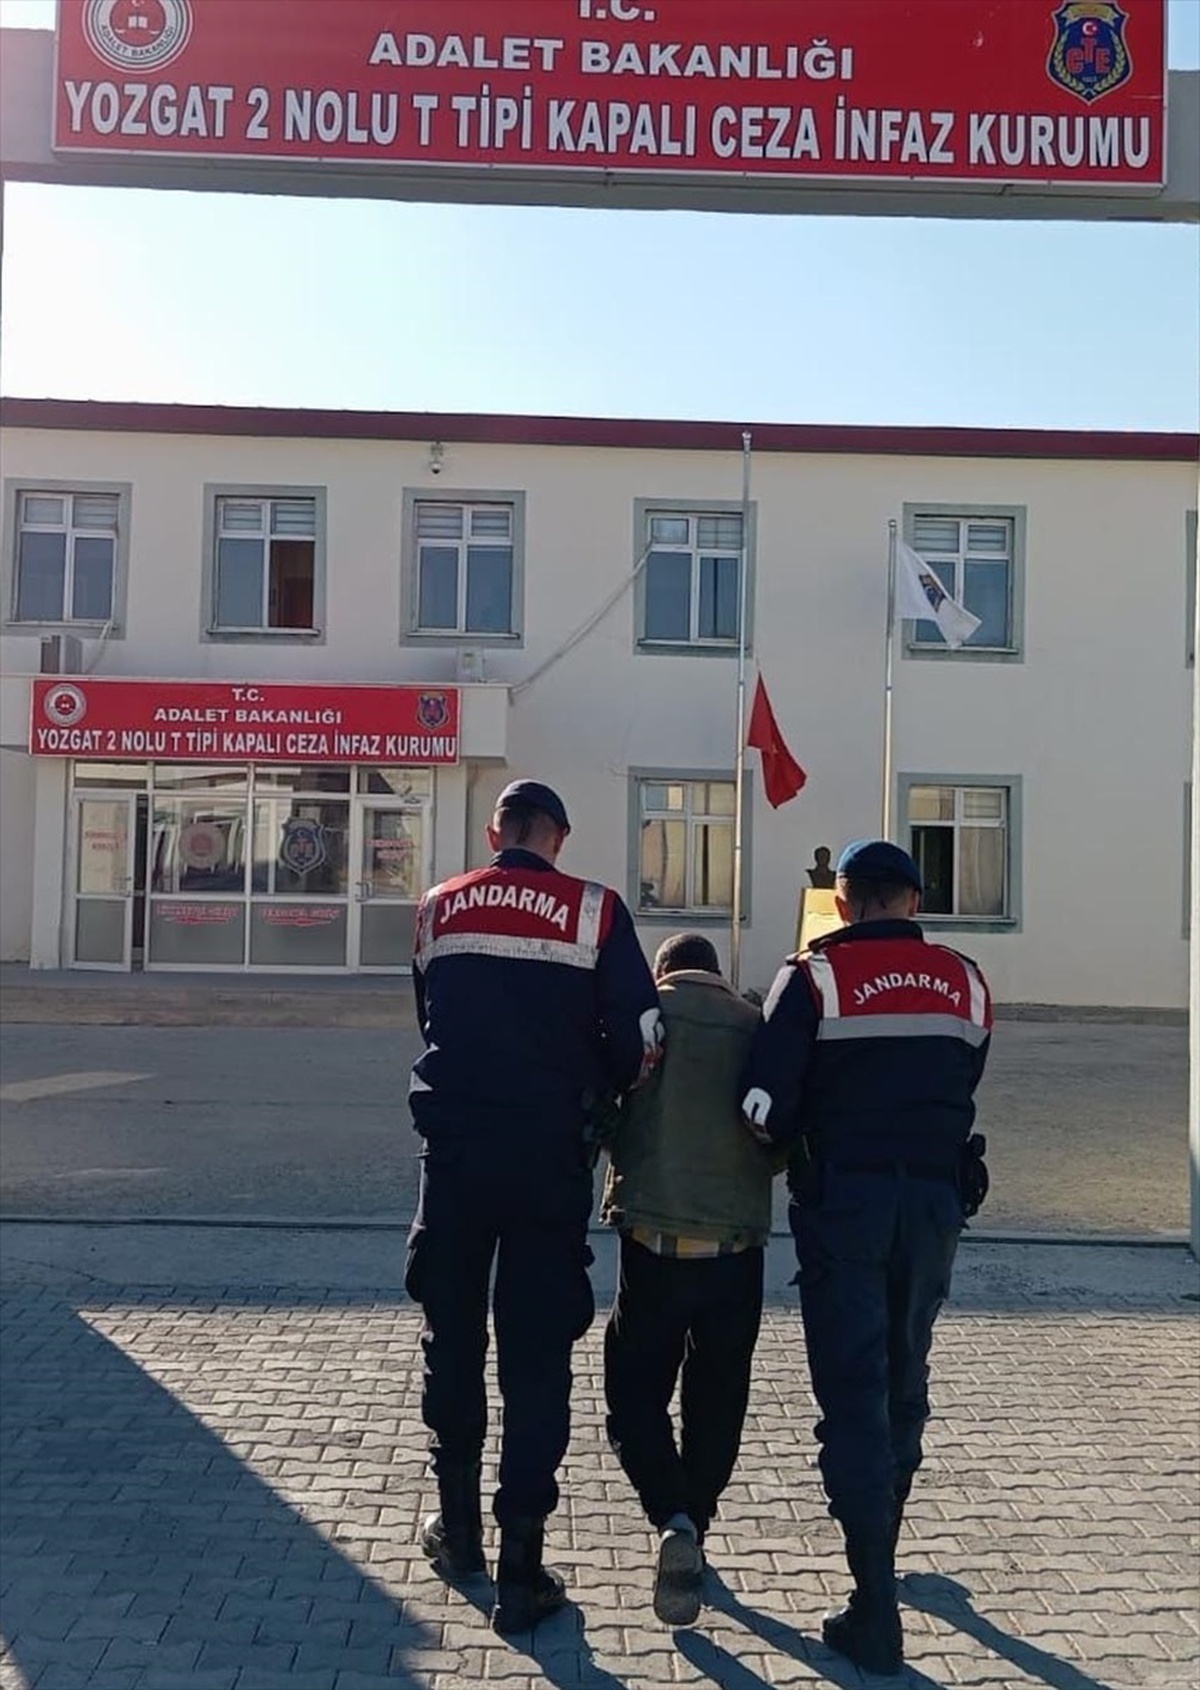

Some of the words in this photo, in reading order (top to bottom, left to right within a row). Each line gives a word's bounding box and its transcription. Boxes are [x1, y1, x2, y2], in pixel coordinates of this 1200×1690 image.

[369, 34, 563, 71] ADALET
[581, 39, 853, 79] BAKANLIĞI
[65, 81, 233, 137] YOZGAT
[245, 88, 270, 140] 2
[284, 90, 399, 145] NOLU
[412, 94, 439, 146] T
[451, 84, 533, 149] TİPİ
[547, 99, 697, 157] KAPALI
[711, 105, 821, 160] CEZA
[834, 95, 955, 164] İNFAZ
[968, 115, 1151, 169] KURUMU
[232, 688, 265, 702] T.C.
[154, 708, 229, 723] ADALET
[235, 708, 342, 724] BAKANLIĞI
[37, 728, 102, 751] YOZGAT
[106, 730, 117, 752] 2
[121, 730, 166, 753] NOLU
[171, 732, 181, 753] T
[186, 727, 218, 753] TİPİ
[223, 733, 281, 754] KAPALI
[286, 734, 329, 755] CEZA
[334, 729, 381, 756] İNFAZ
[386, 735, 457, 757] KURUMU
[440, 884, 569, 932] JANDARMA
[853, 972, 962, 1007] JANDARMA
